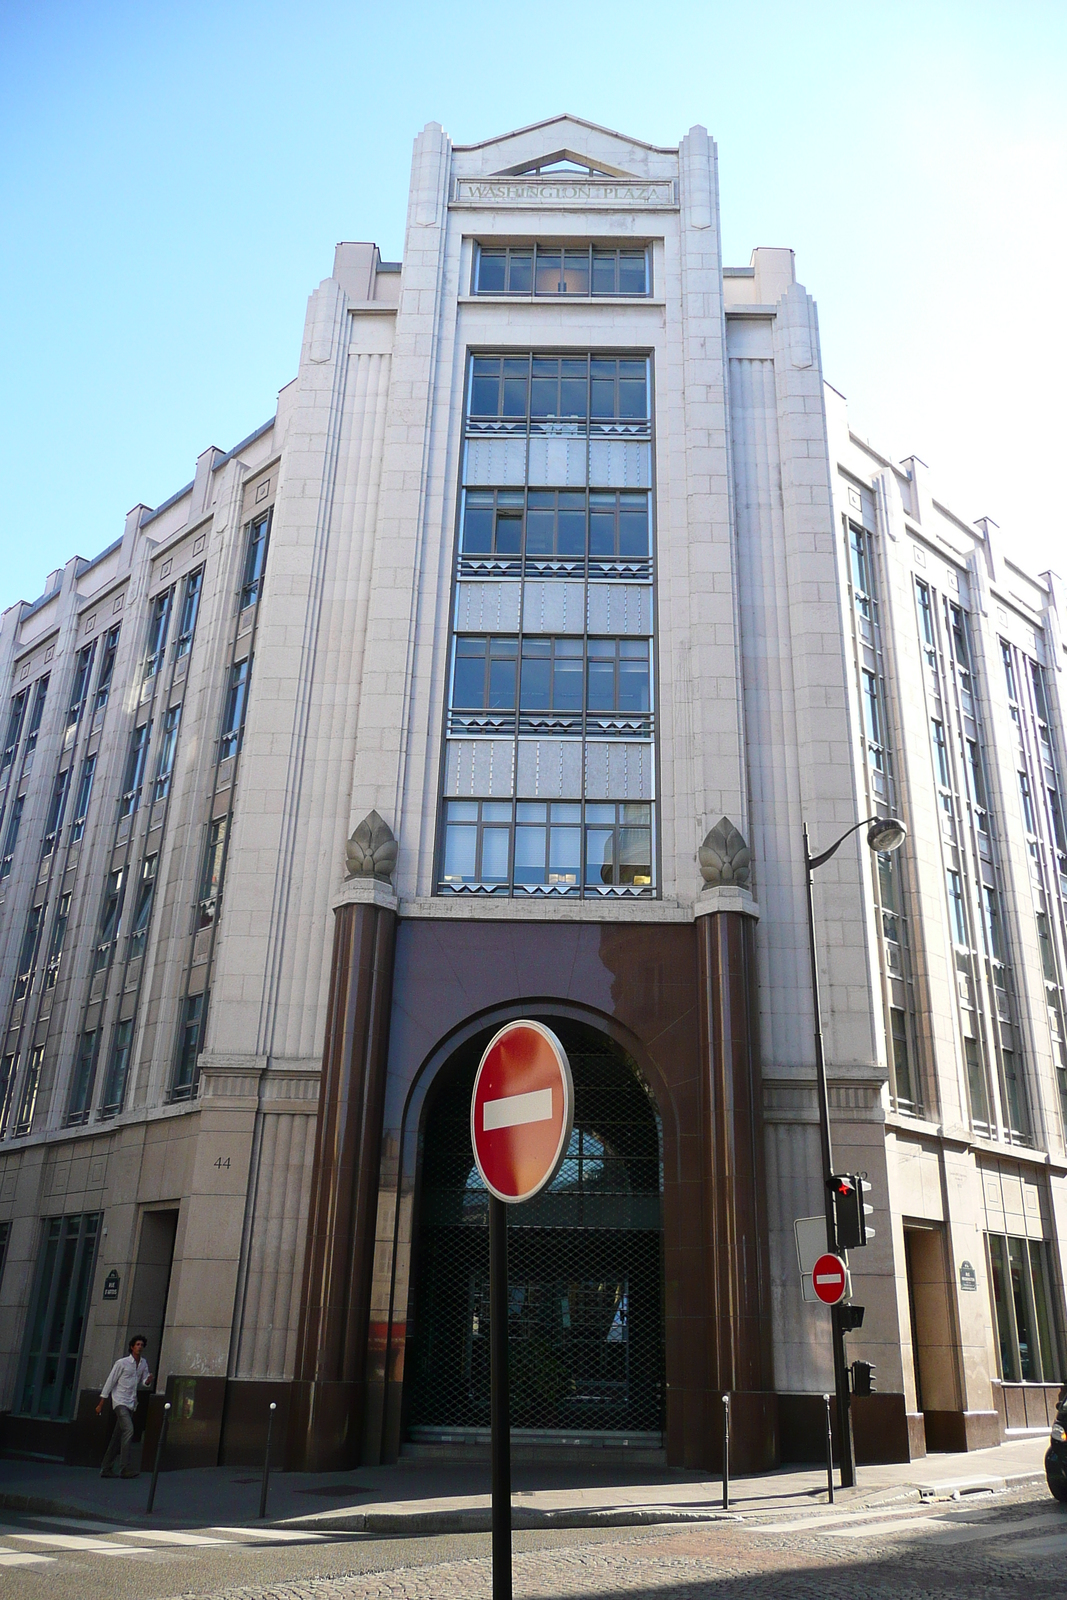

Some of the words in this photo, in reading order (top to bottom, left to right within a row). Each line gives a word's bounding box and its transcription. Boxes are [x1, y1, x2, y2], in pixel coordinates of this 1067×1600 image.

[468, 186, 591, 199] WASHINGTON
[603, 187, 660, 199] PLAZA
[213, 1156, 231, 1170] 44
